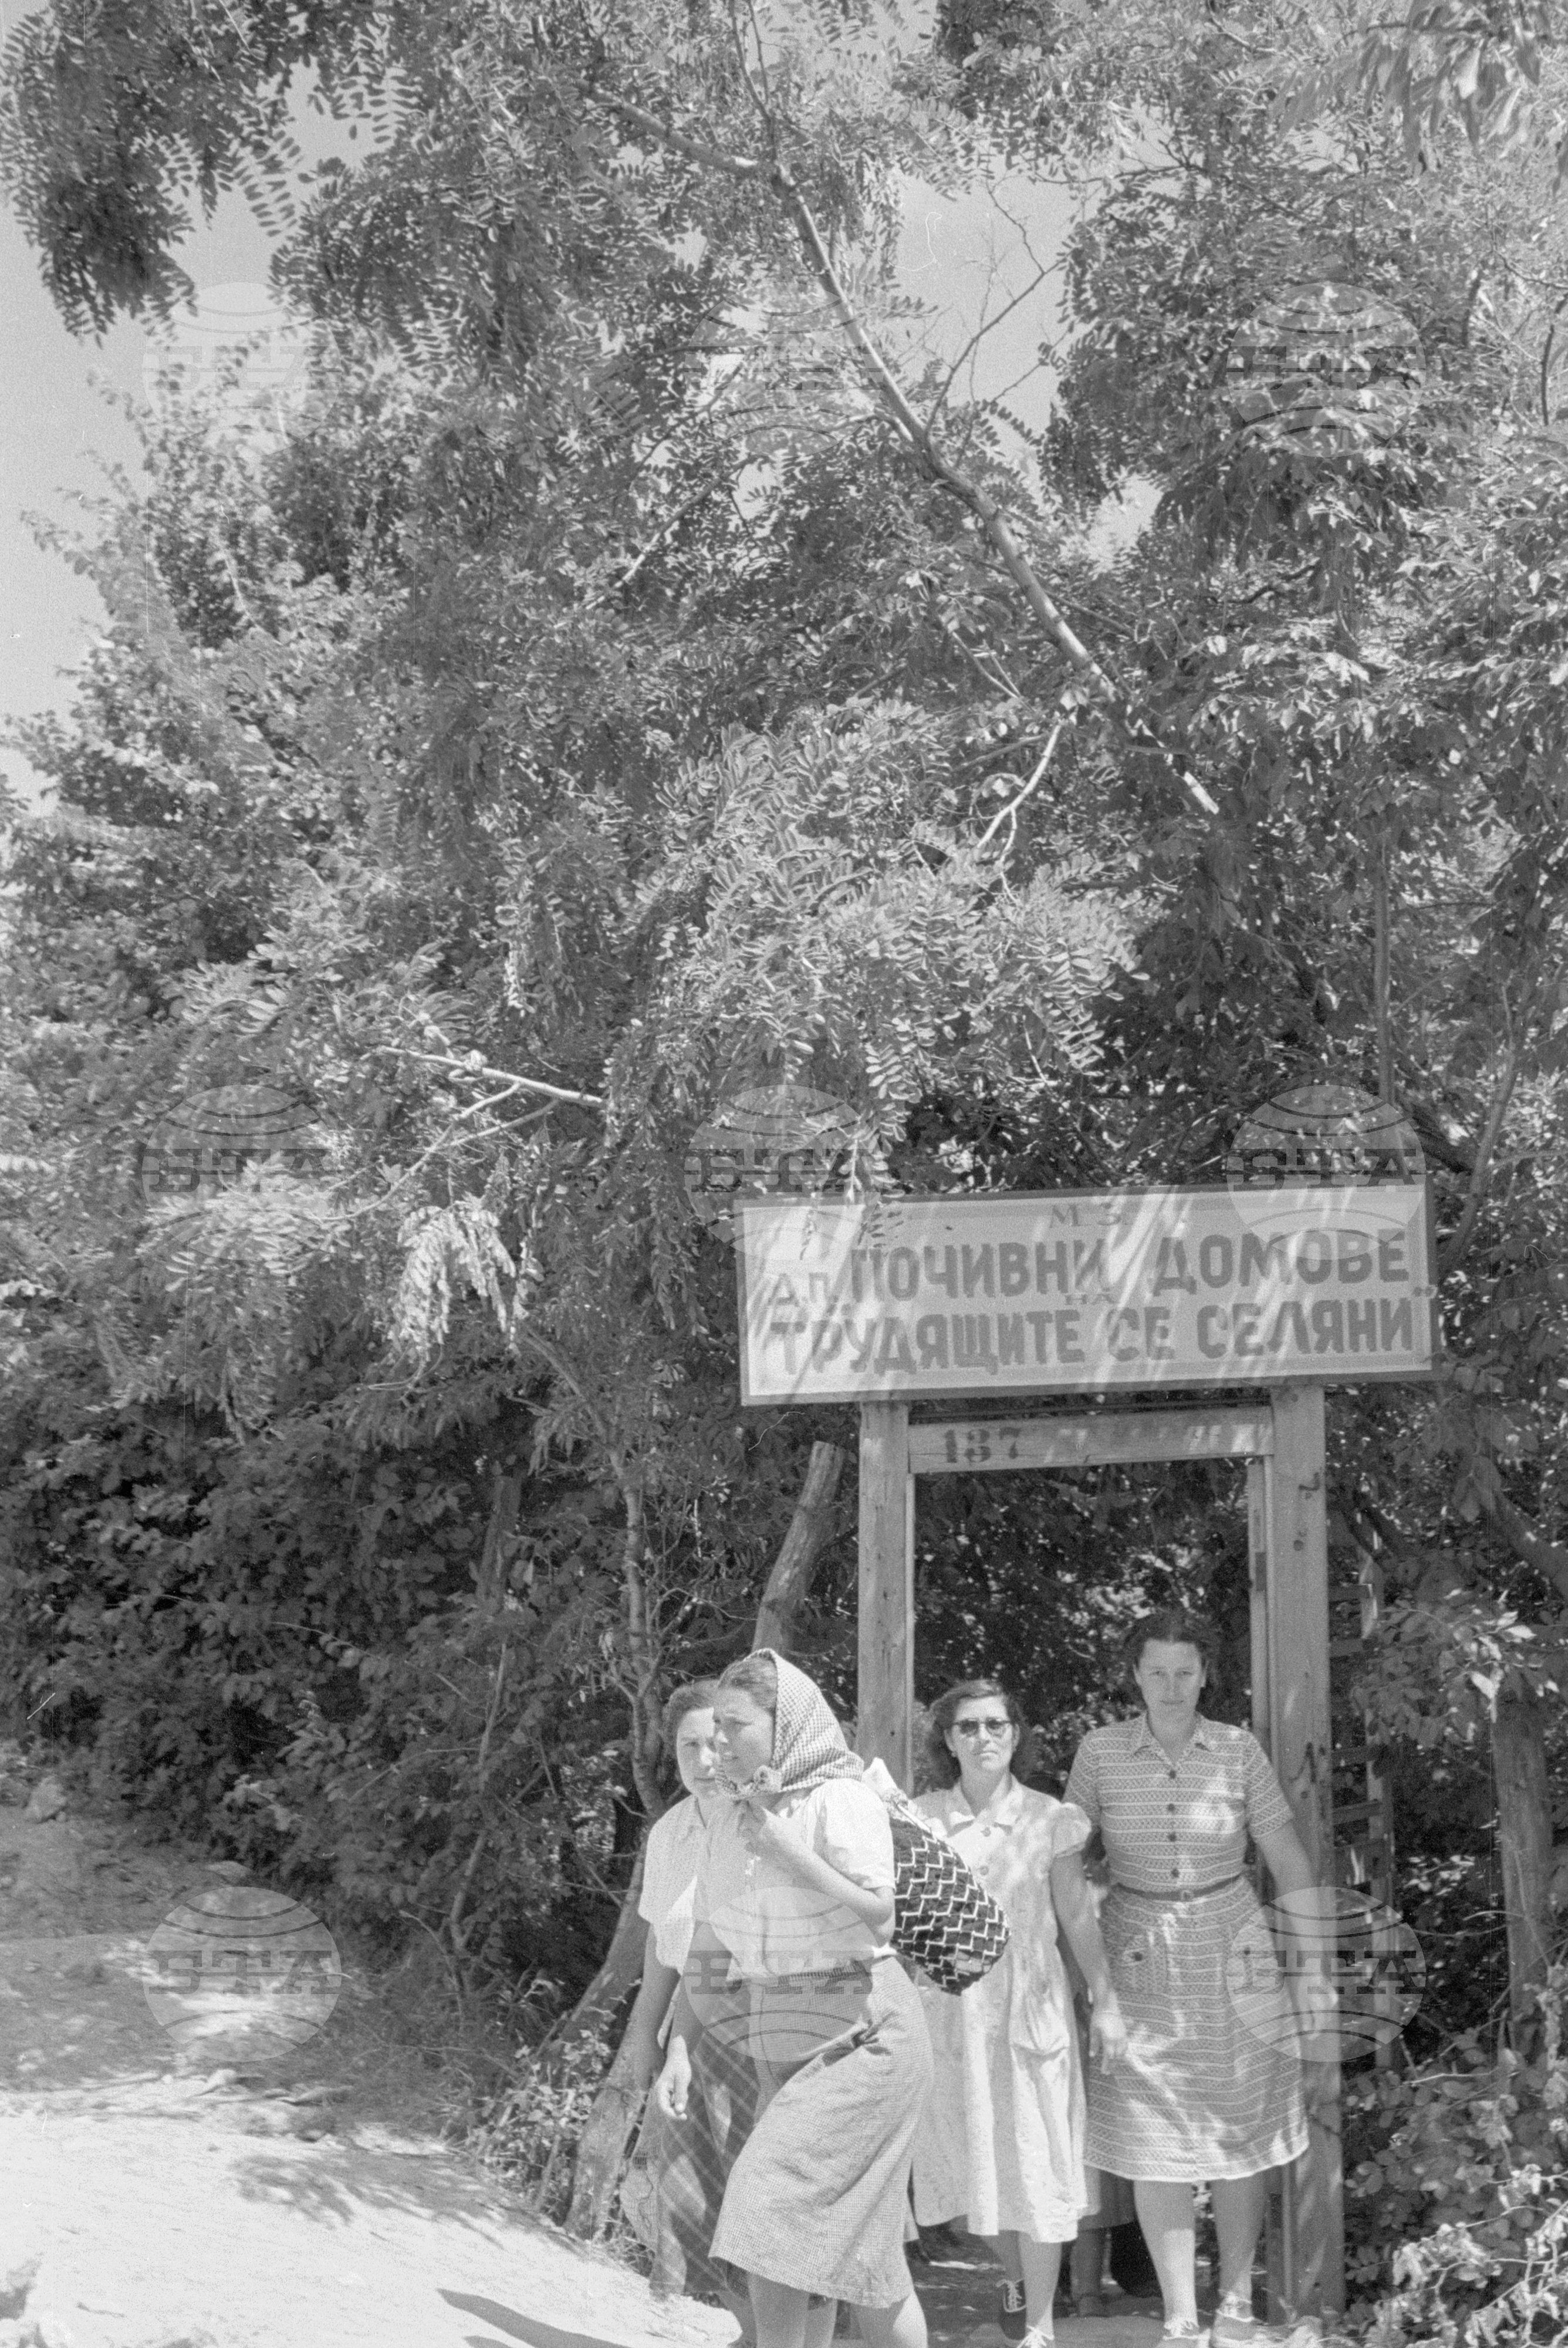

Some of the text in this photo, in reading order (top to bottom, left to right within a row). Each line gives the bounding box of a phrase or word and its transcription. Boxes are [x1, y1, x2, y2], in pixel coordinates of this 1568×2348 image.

[1154, 1228, 1409, 1297] ДОМОВЕ
[769, 1310, 1086, 1377] ТРУДЯЩИТЕ
[1107, 1306, 1174, 1362] СЕ
